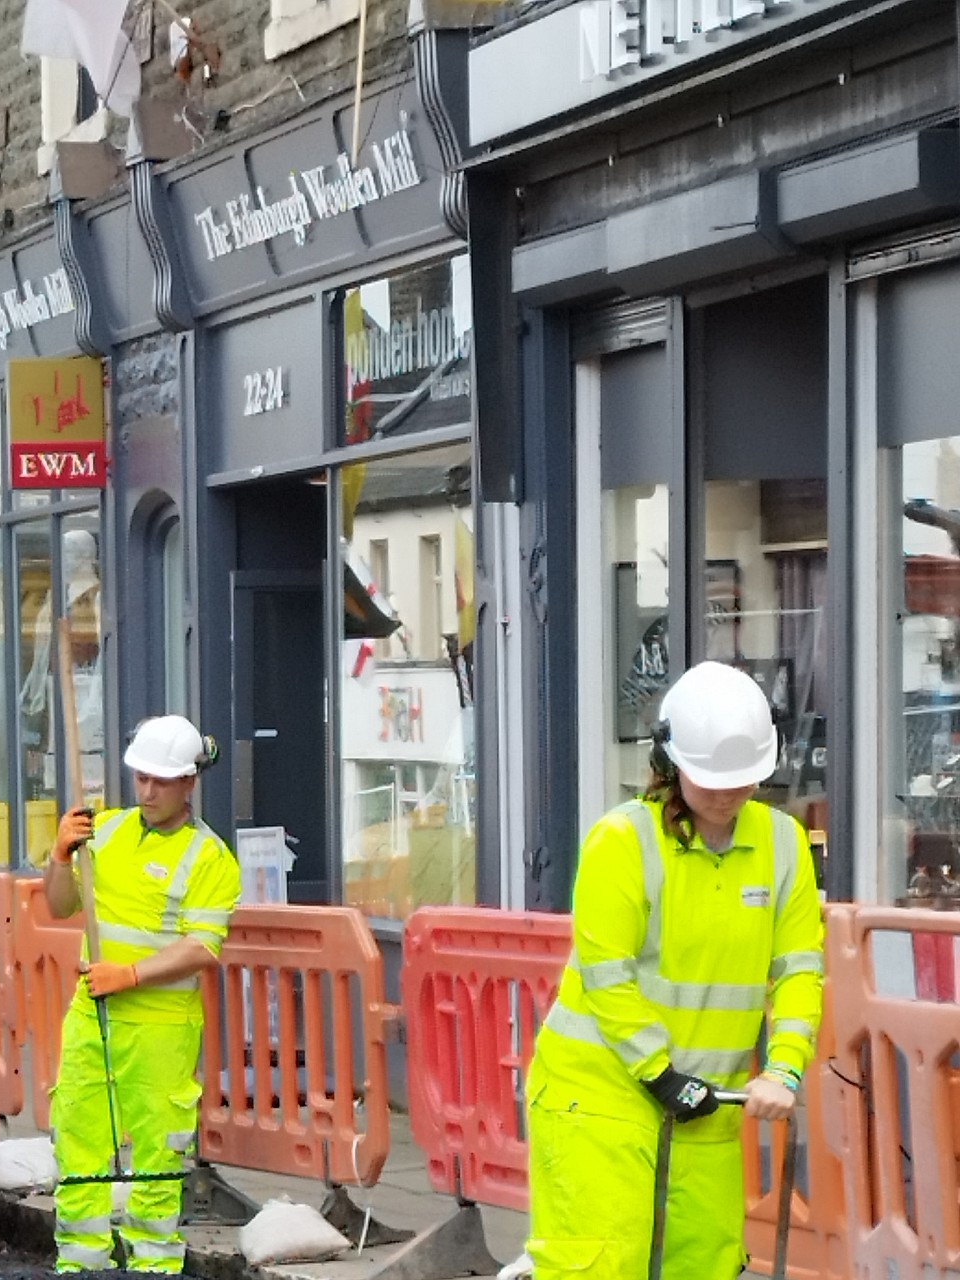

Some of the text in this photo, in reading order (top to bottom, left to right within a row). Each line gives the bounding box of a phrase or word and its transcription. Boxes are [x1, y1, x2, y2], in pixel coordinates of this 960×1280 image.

[194, 129, 420, 261] The Edinburgh Woollen Mill
[3, 279, 51, 329] Woollen
[243, 366, 283, 417] 22-24
[18, 452, 97, 478] EWM
